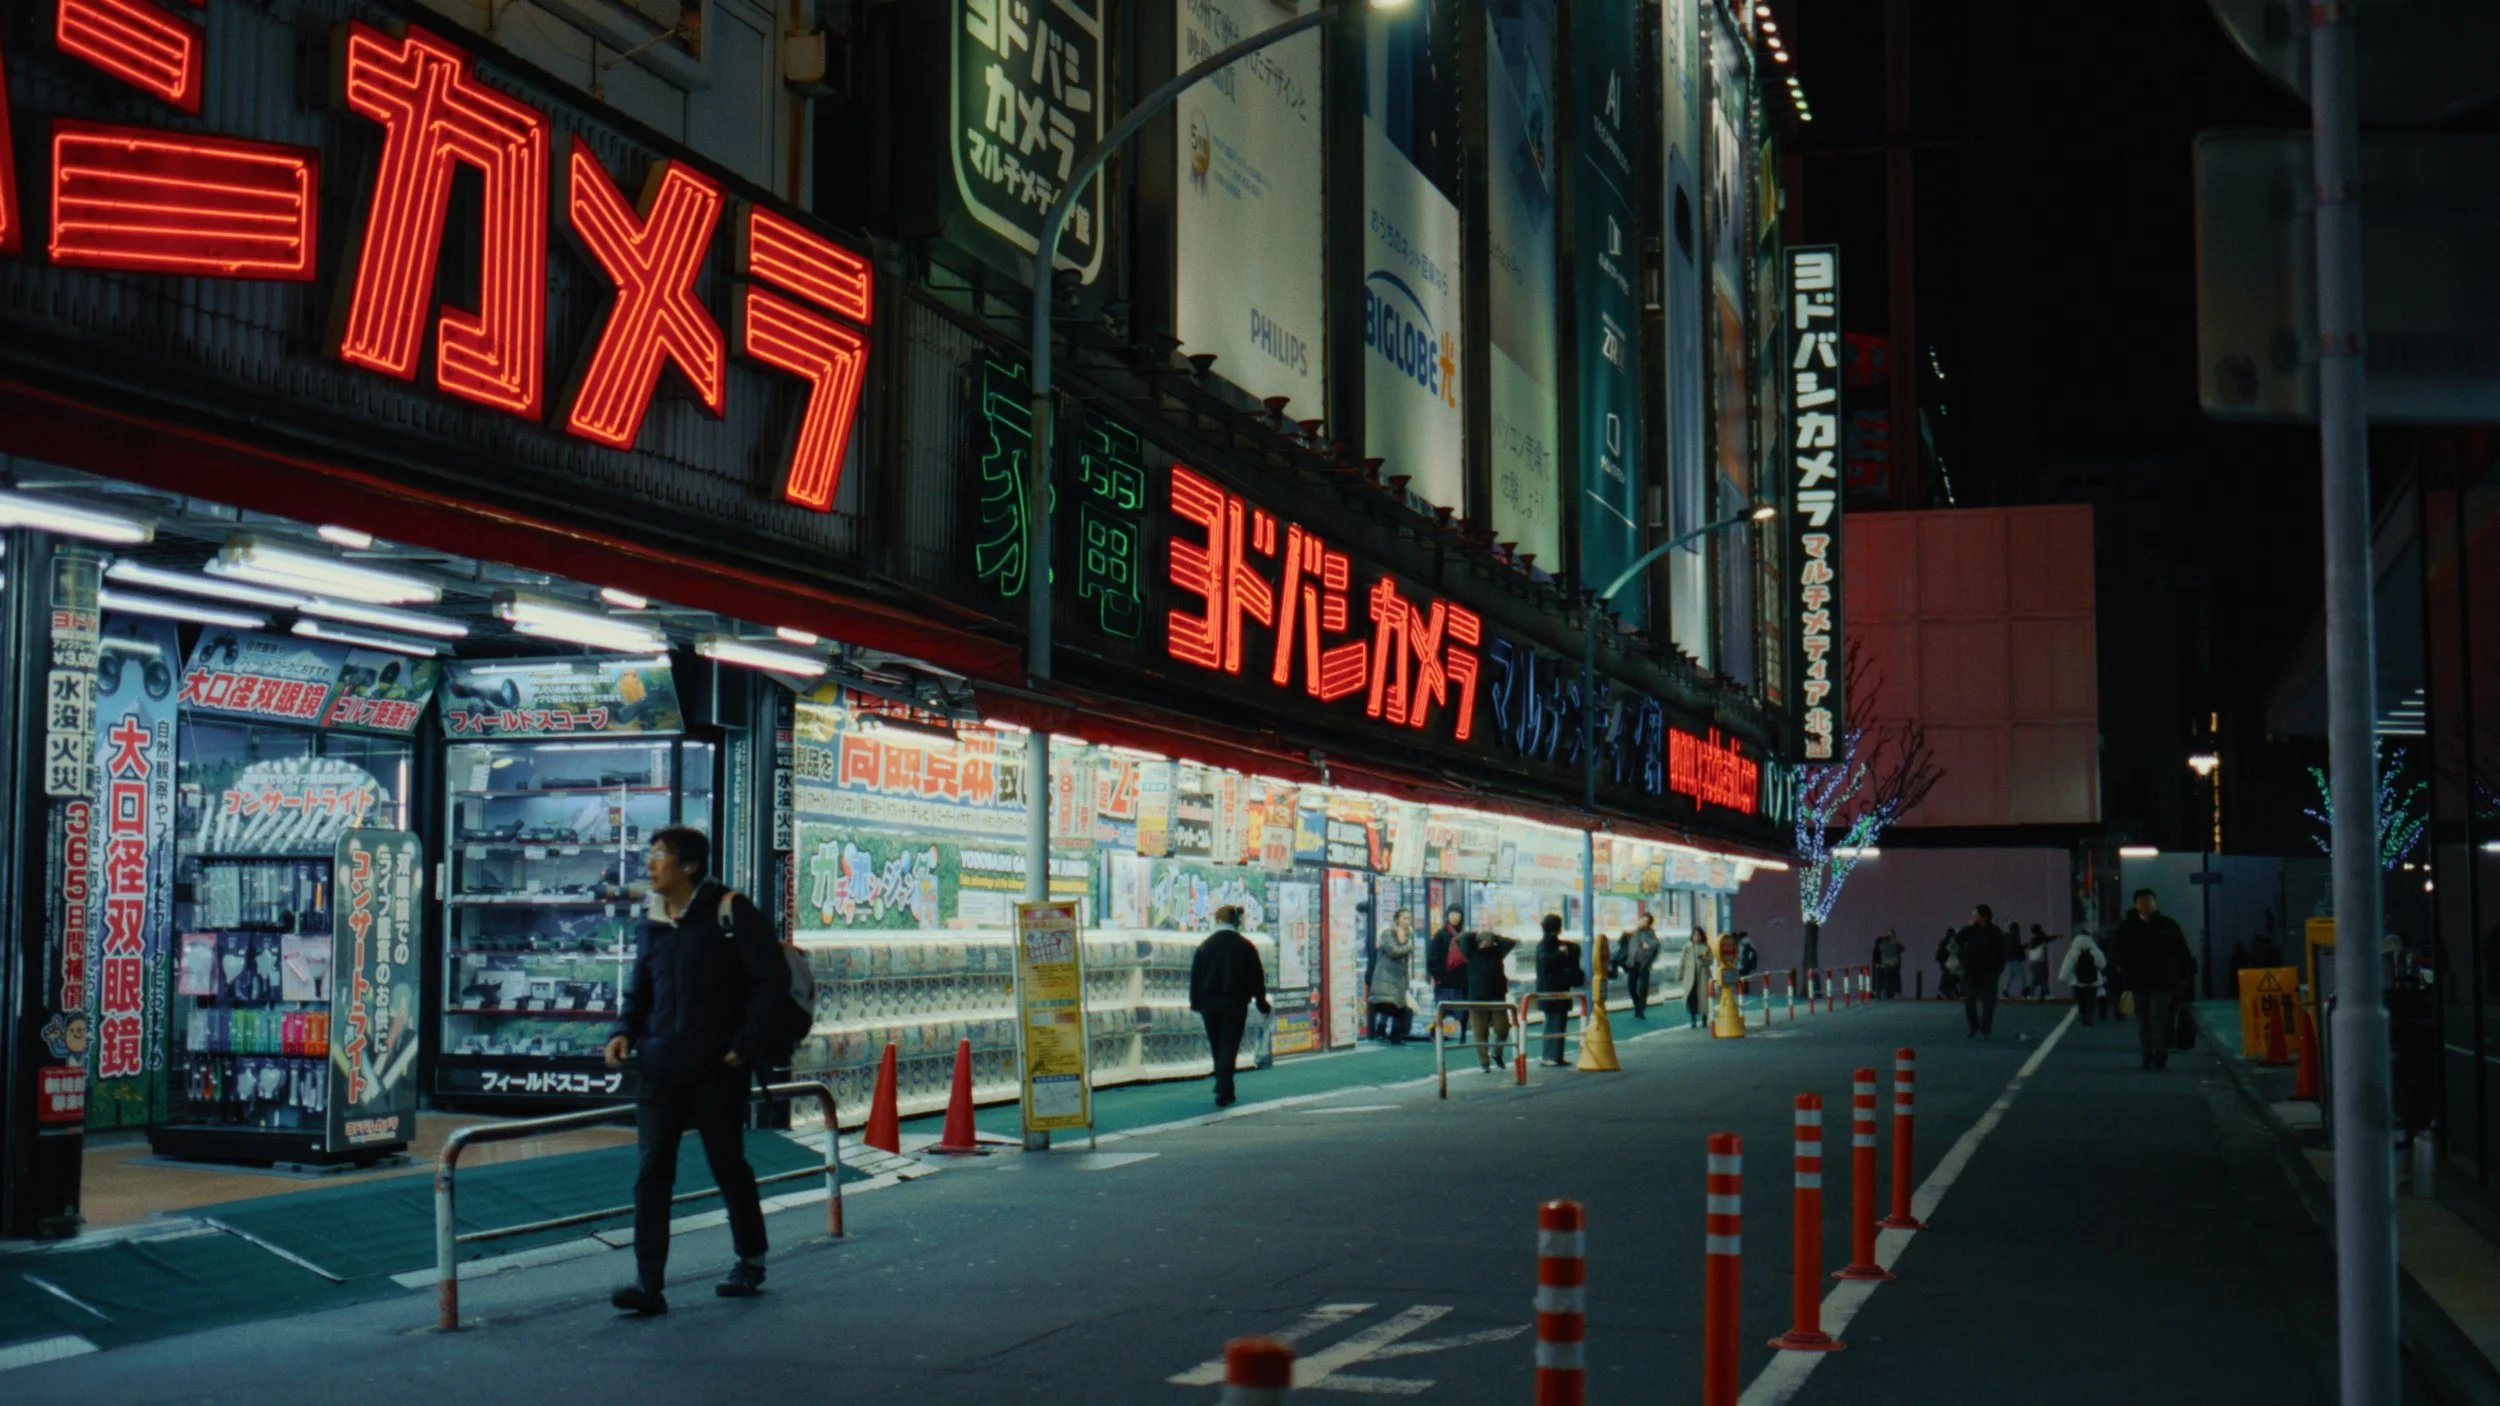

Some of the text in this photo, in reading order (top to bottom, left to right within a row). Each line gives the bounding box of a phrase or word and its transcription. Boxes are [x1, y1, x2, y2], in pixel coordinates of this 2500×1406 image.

[985, 63, 1077, 183] カメラ
[1250, 308, 1308, 378] PHILIPS
[1364, 286, 1457, 409] BIGLOBE 光
[1793, 252, 1837, 527] ヨドバシカメラ
[1167, 461, 1482, 742] ヨドバシカメラ
[53, 676, 81, 729] 水没
[177, 667, 328, 719] 大口径双眼鏡
[331, 696, 420, 732] ゴルフ距離計
[448, 706, 610, 734] フィールドスコープ
[50, 737, 79, 792] 火災
[776, 769, 793, 809] 水没
[224, 786, 374, 816] コンサートライト
[775, 810, 792, 850] 火災
[100, 713, 153, 1079] 大口径双眼鏡
[394, 851, 412, 965] 双眼鏡での
[346, 850, 374, 1105] コンサートライト
[480, 1070, 623, 1094] フィールドスコープ
